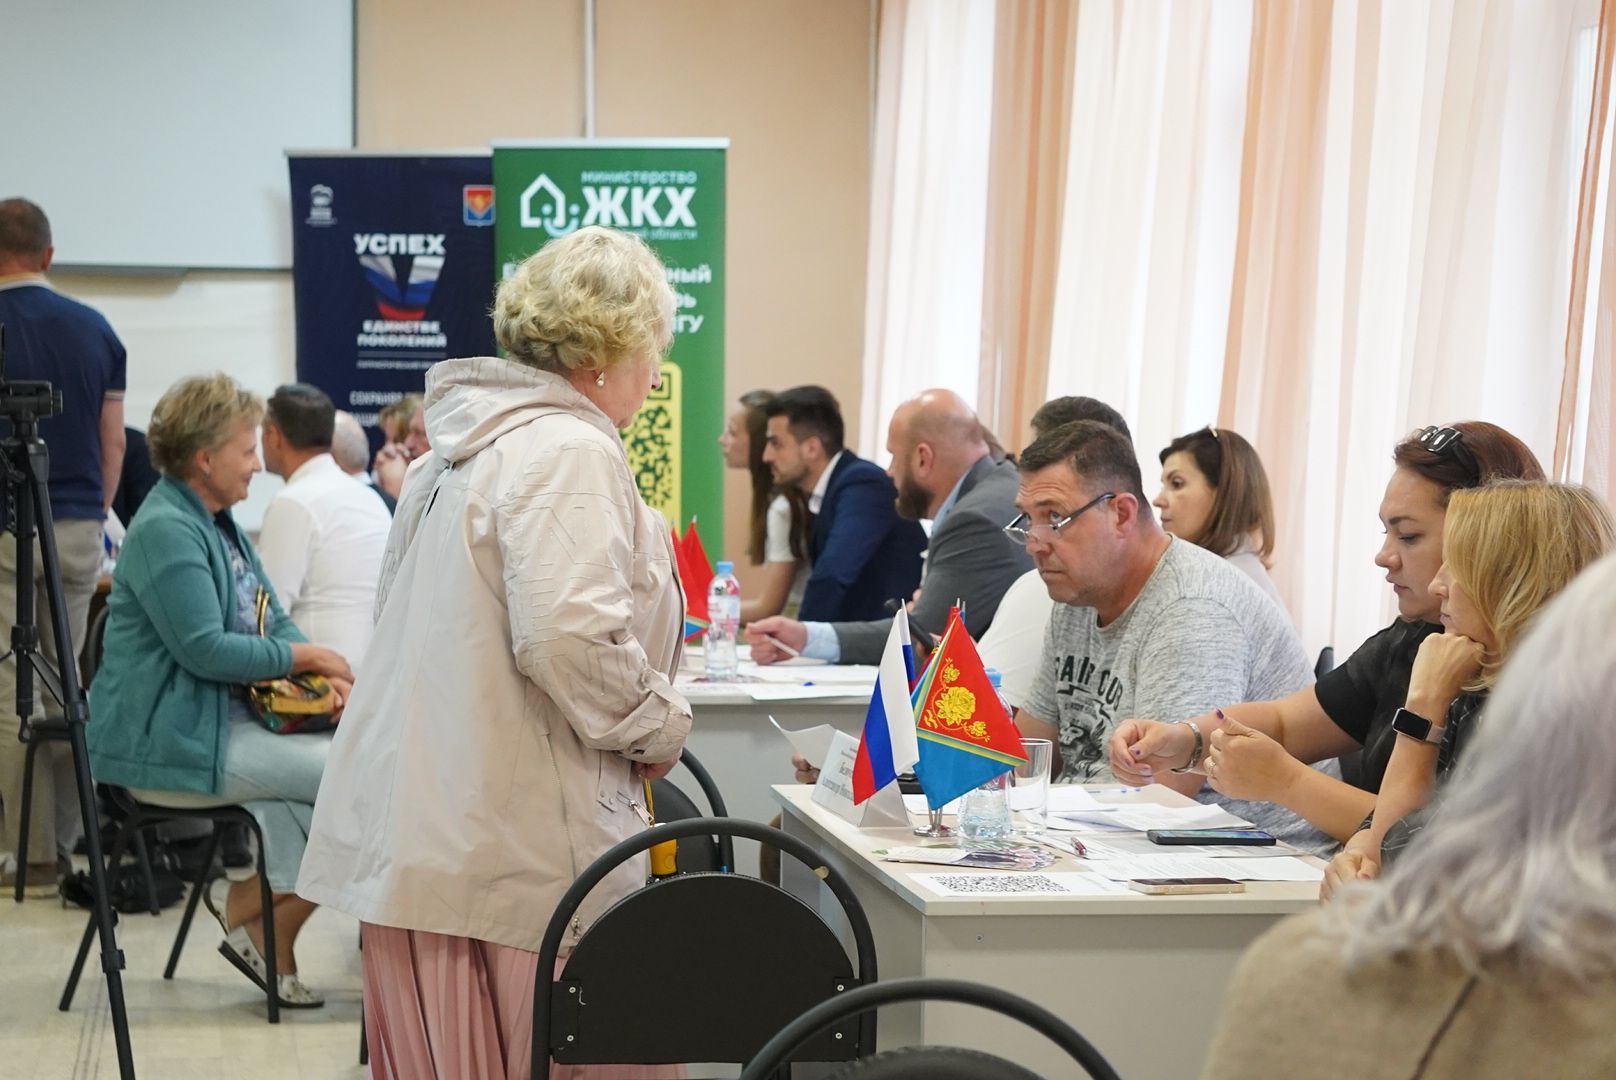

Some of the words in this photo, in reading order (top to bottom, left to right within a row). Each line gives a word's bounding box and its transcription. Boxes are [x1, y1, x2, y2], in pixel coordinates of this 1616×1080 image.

[582, 186, 697, 227] ЖКХ
[353, 233, 446, 254] УСПЕХ
[357, 332, 447, 347] ПОКОЛЕНИЙ
